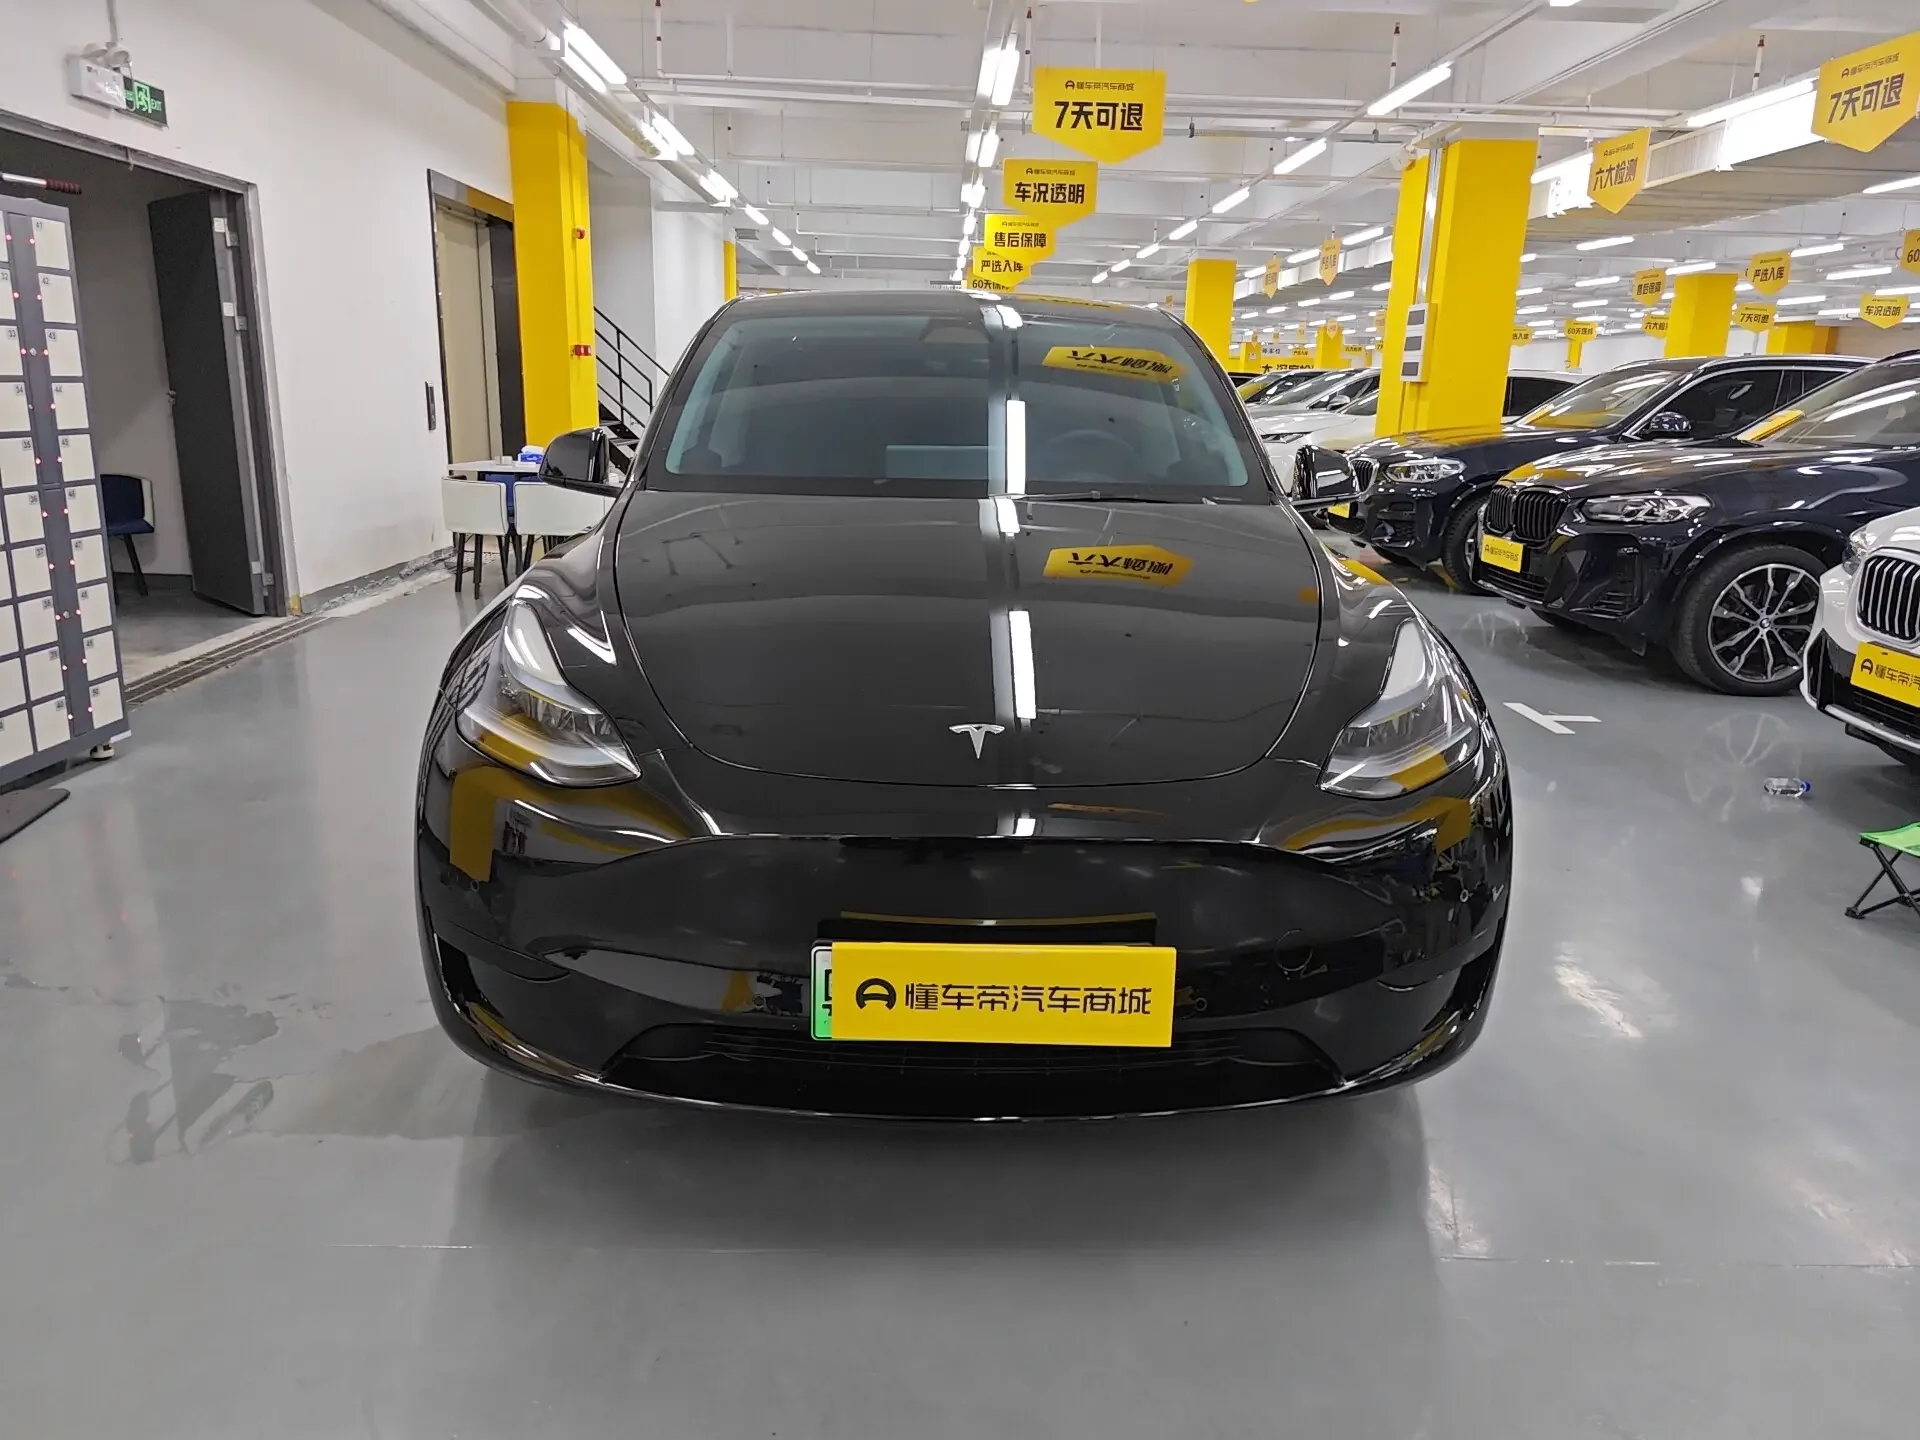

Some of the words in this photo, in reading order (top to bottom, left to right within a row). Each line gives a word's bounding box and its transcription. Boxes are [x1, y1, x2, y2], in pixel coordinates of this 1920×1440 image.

[1828, 73, 1904, 124] 7天可退
[1054, 100, 1144, 131] 7天可退
[1593, 157, 1638, 191] 六大检测
[1014, 181, 1085, 204] 车况透明
[994, 231, 1047, 248] 售后保障
[980, 259, 1024, 272] 严选入库
[1752, 266, 1785, 282] 严选入库
[42, 277, 49, 285] 42
[1865, 305, 1902, 316] 车况透明
[8, 329, 16, 338] 33
[48, 331, 56, 340] 43
[16, 385, 23, 394] 34
[23, 441, 31, 449] 35
[61, 438, 69, 446] 45
[904, 982, 1153, 1015] 懂车帝汽车商城
